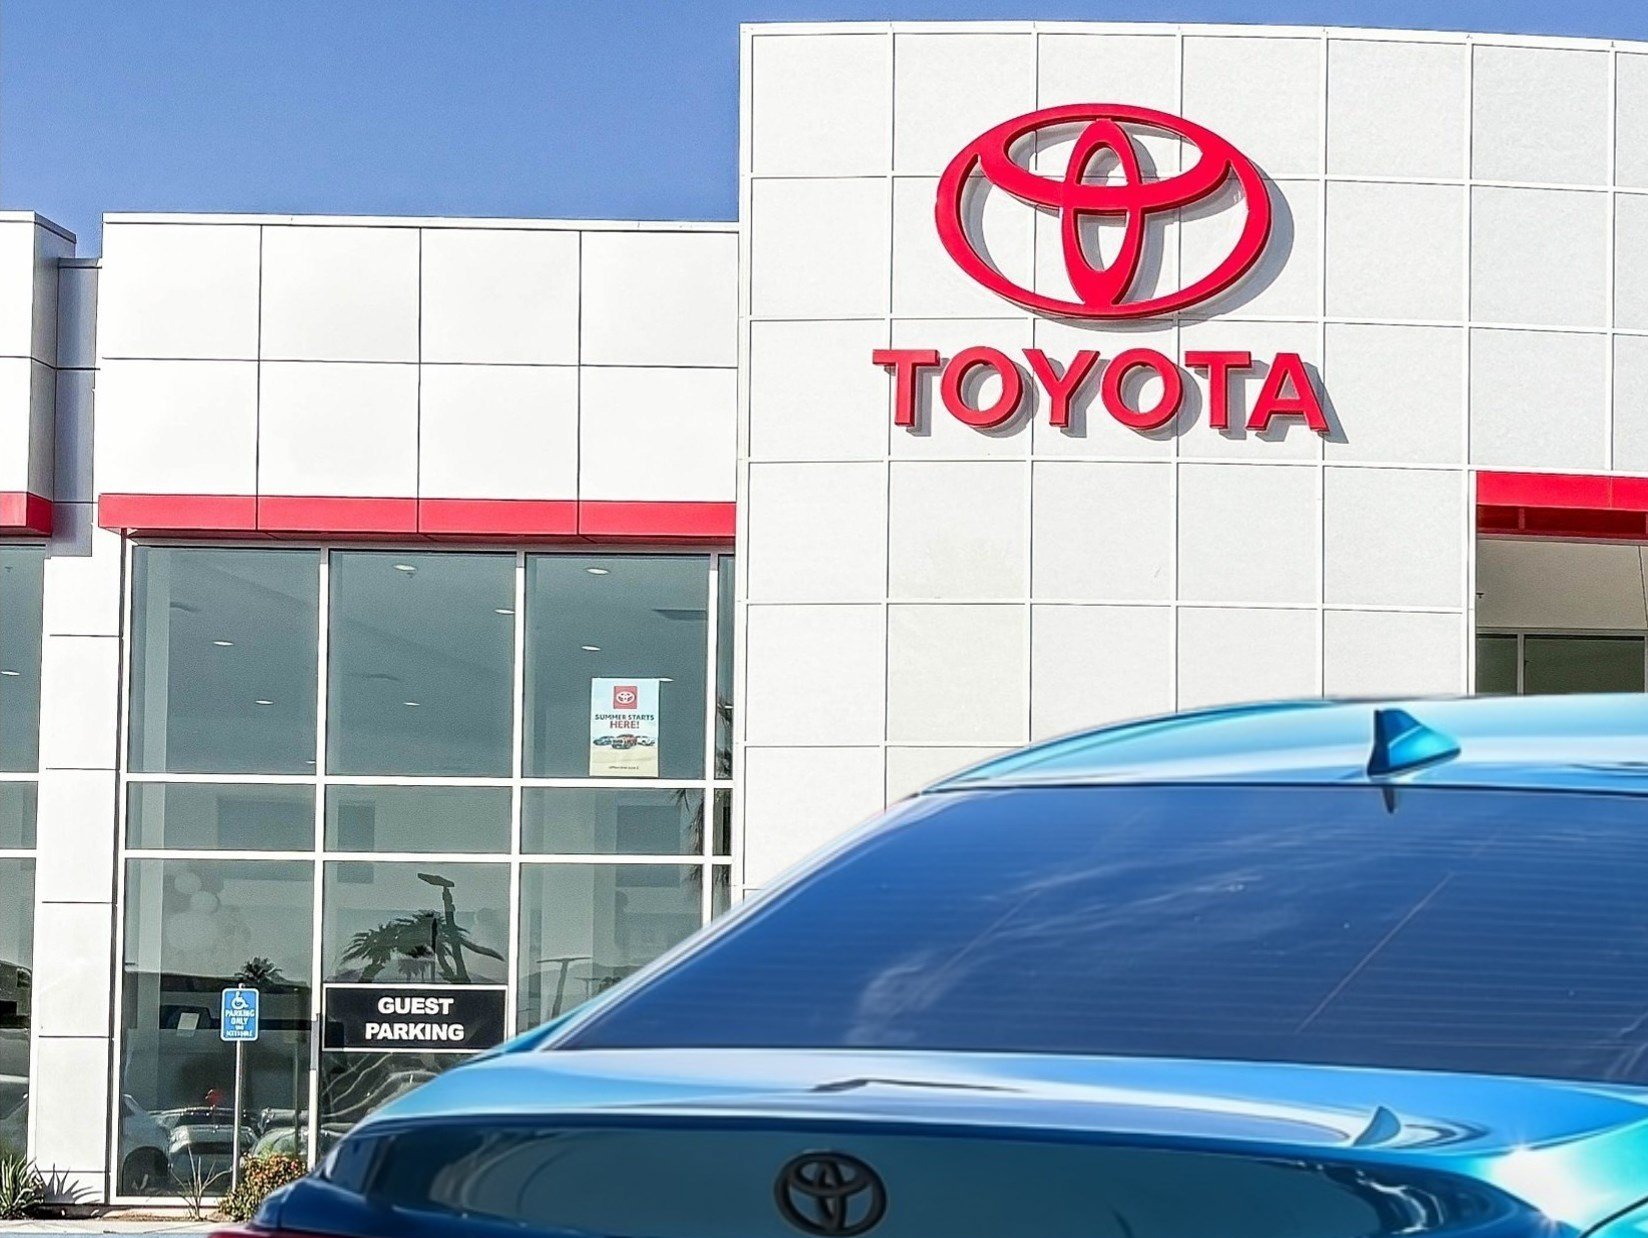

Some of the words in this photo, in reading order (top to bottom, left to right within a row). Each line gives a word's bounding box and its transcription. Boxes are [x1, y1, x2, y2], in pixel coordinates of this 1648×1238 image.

[873, 346, 1330, 432] TOYOTA
[609, 720, 640, 729] HERE!
[378, 997, 454, 1015] GUEST
[225, 1009, 255, 1017] PARKING
[230, 1017, 249, 1025] ONLY
[365, 1022, 464, 1041] PARKING
